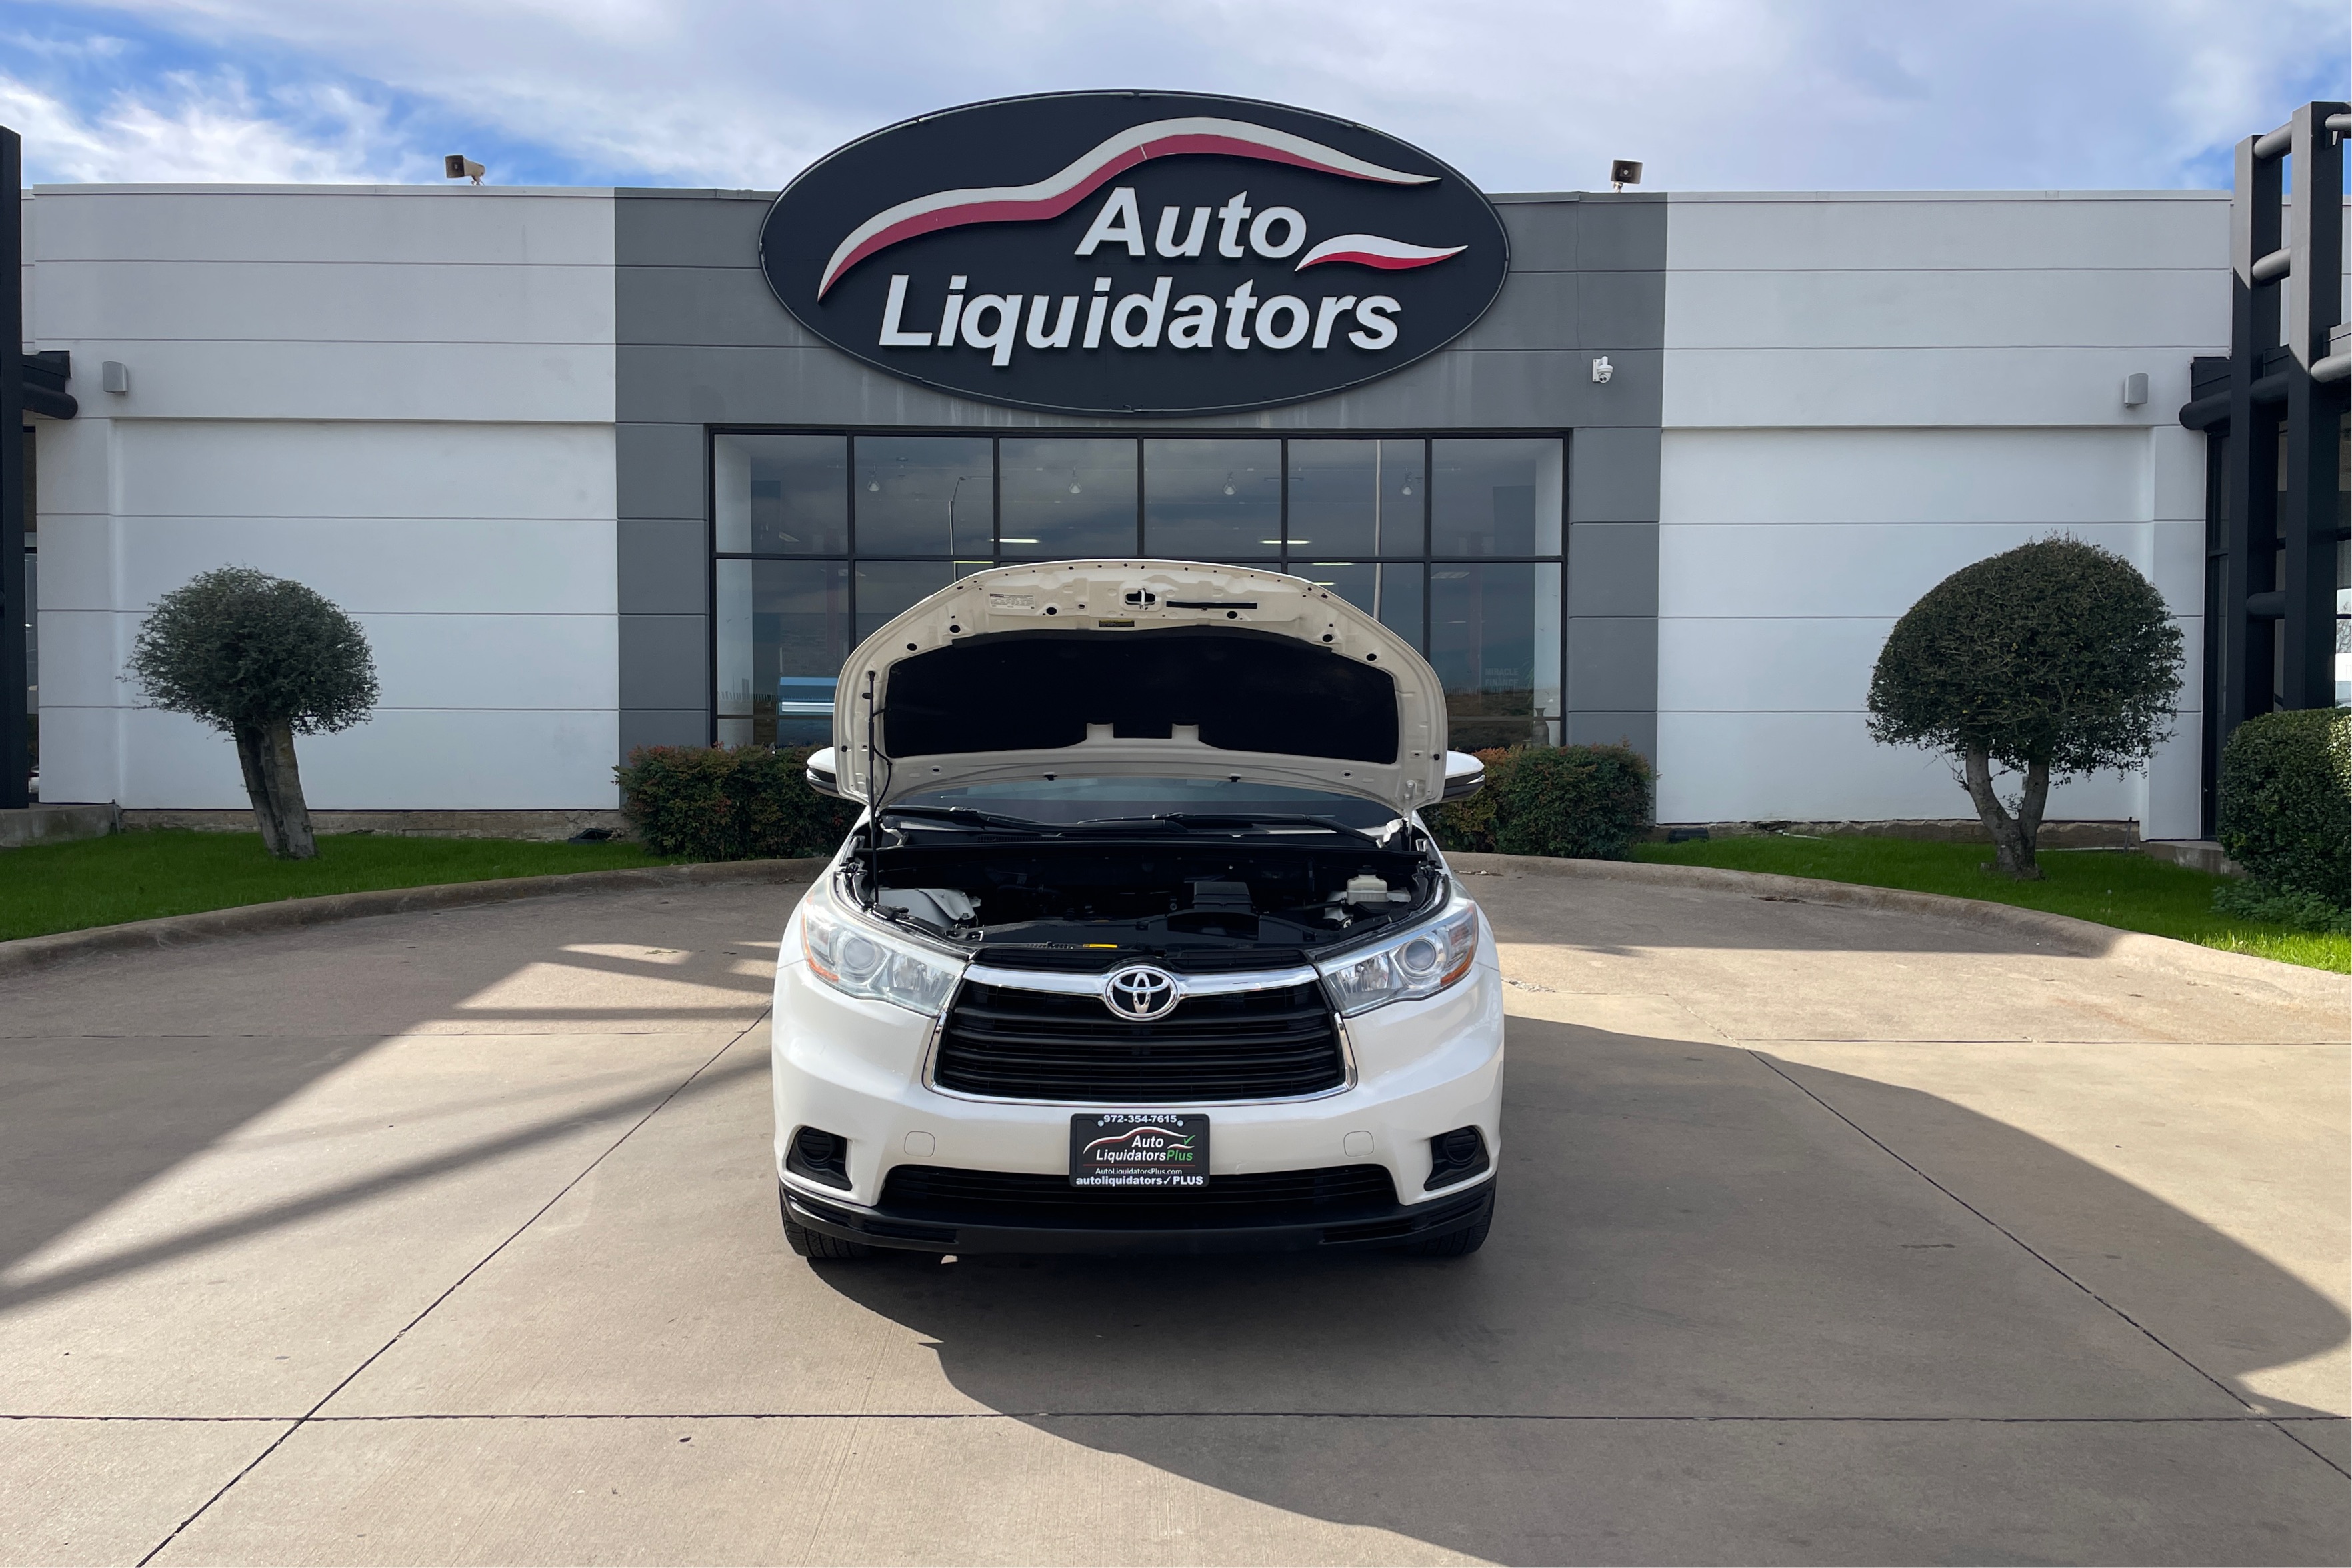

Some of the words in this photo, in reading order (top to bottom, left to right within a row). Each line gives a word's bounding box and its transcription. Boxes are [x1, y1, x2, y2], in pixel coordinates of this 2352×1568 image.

[1074, 187, 1307, 259] Auto
[878, 274, 1402, 367] Liquidators
[1485, 667, 1519, 676] MIRACLE
[1485, 679, 1519, 687] FINANCE
[1103, 1115, 1177, 1123] 972-354-7615
[1131, 1135, 1164, 1148] Auto
[1076, 1175, 1163, 1187] autoliquidators
[1173, 1175, 1203, 1185] PLUS
